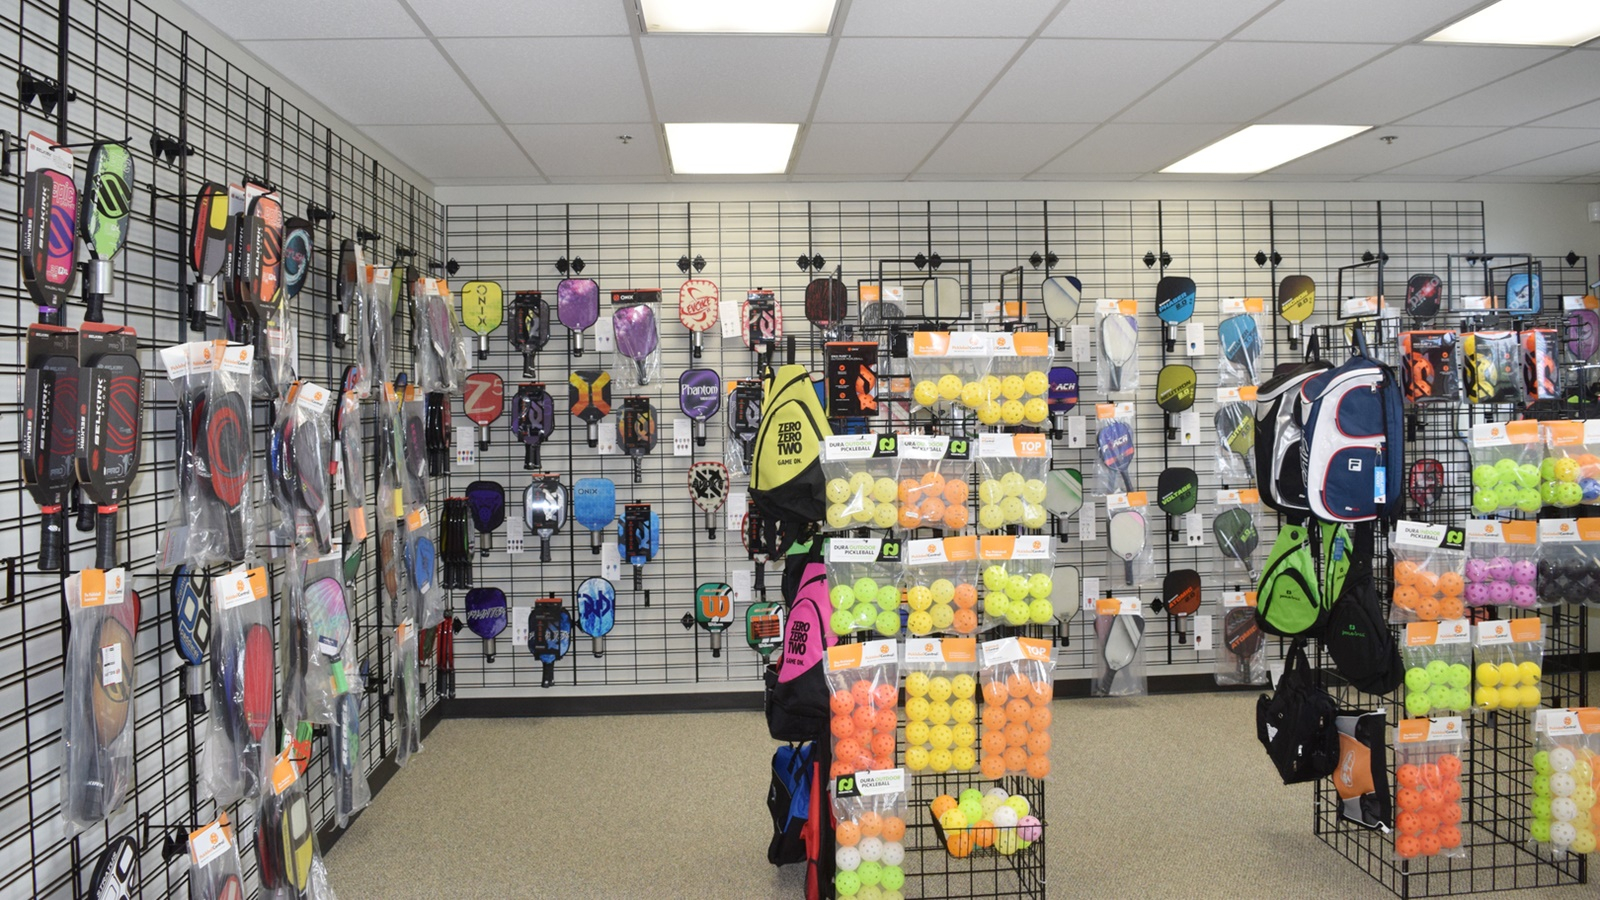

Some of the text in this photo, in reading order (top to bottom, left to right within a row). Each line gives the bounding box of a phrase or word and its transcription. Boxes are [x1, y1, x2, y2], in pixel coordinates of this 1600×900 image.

[38, 185, 47, 249] SELKIRK
[476, 284, 488, 327] ONIX
[681, 384, 718, 396] Phantom
[40, 382, 48, 450] SELKIRK
[94, 378, 104, 446] SELKIRK
[778, 421, 802, 433] ZERO
[778, 432, 802, 443] ZERO
[777, 442, 803, 455] TWO
[1021, 441, 1042, 451] TOP
[778, 458, 792, 466] GAME
[1161, 483, 1192, 505] VOLTAGE
[1410, 533, 1439, 541] PICKLEBALL
[1168, 586, 1193, 609] ATOMIC
[701, 596, 729, 618] W
[792, 620, 810, 632] ZERO
[790, 631, 808, 643] ZERO
[1231, 625, 1258, 650] ATOMIC
[788, 642, 807, 656] TWO
[1026, 645, 1047, 656] TOP
